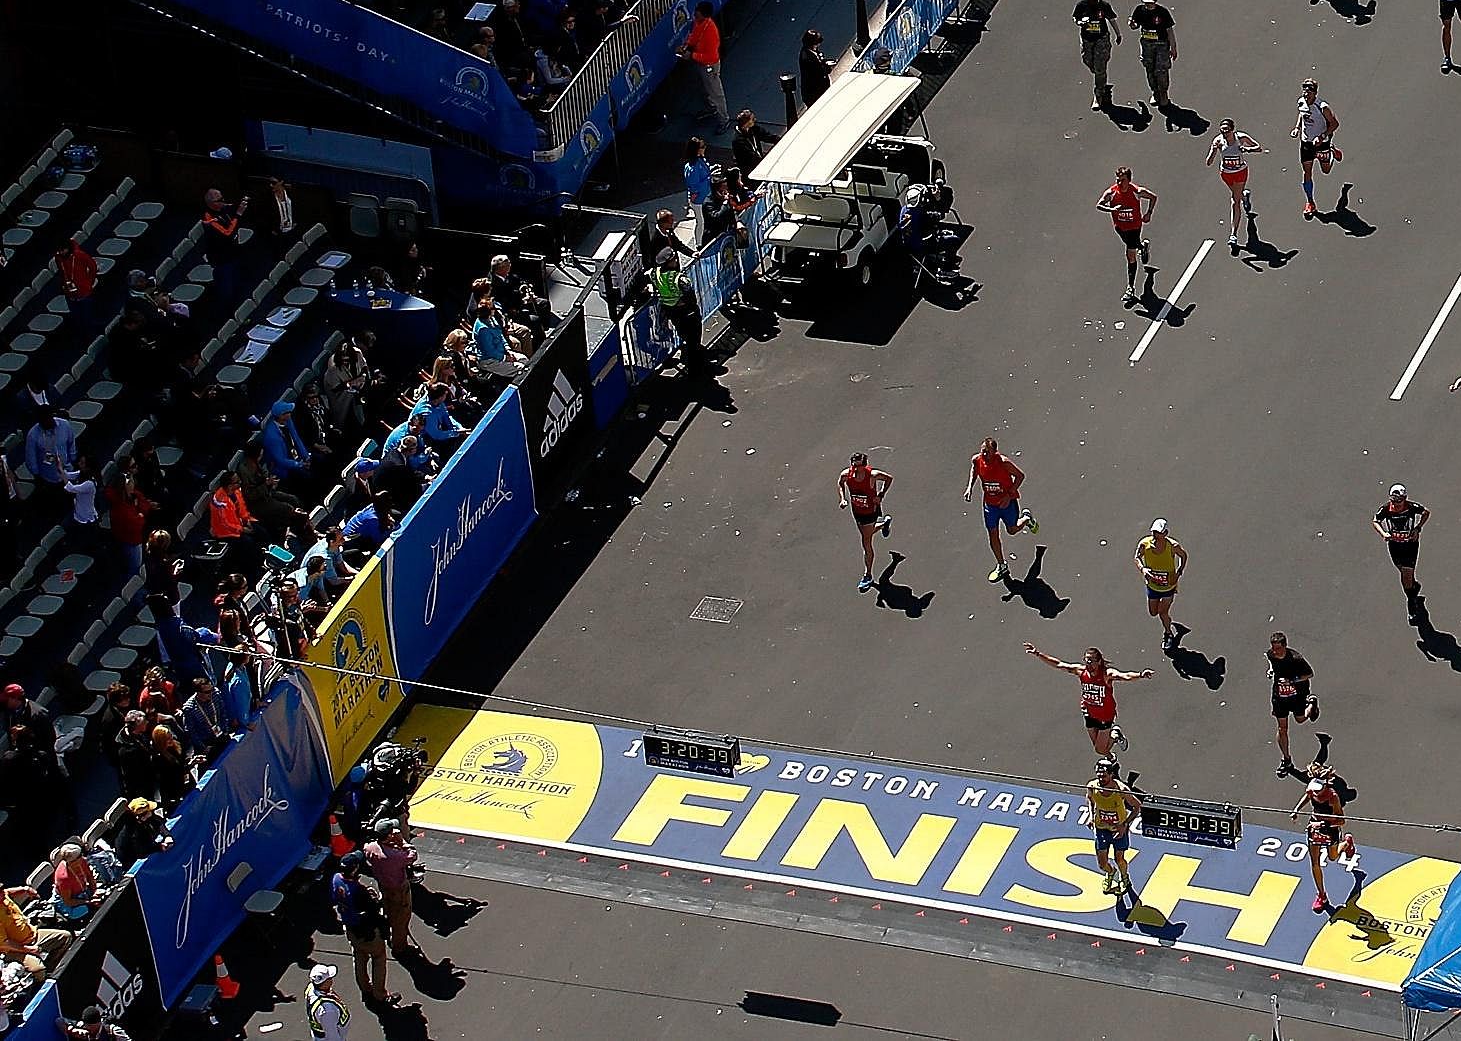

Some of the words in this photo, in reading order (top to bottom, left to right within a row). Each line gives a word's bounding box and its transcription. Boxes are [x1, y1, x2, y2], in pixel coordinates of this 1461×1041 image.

[264, 2, 349, 43] PATRIOTS'
[355, 41, 390, 62] DAY
[540, 392, 584, 458] adidas
[424, 527, 457, 626] John
[455, 455, 514, 552] Hancock
[334, 657, 384, 730] MARATHON
[349, 639, 381, 688] BOSTON
[660, 740, 728, 764] 3:20:39
[462, 788, 542, 820] Hancock
[480, 775, 575, 795] MARATHON
[777, 760, 940, 801] BOSTON
[956, 785, 1145, 836] MARATO
[1255, 836, 1362, 873] 2014
[1159, 812, 1230, 836] 3:20:39
[175, 843, 213, 949] John
[209, 763, 289, 872] Hancock
[611, 773, 1302, 947] FINISH
[1358, 916, 1428, 938] BOSTON
